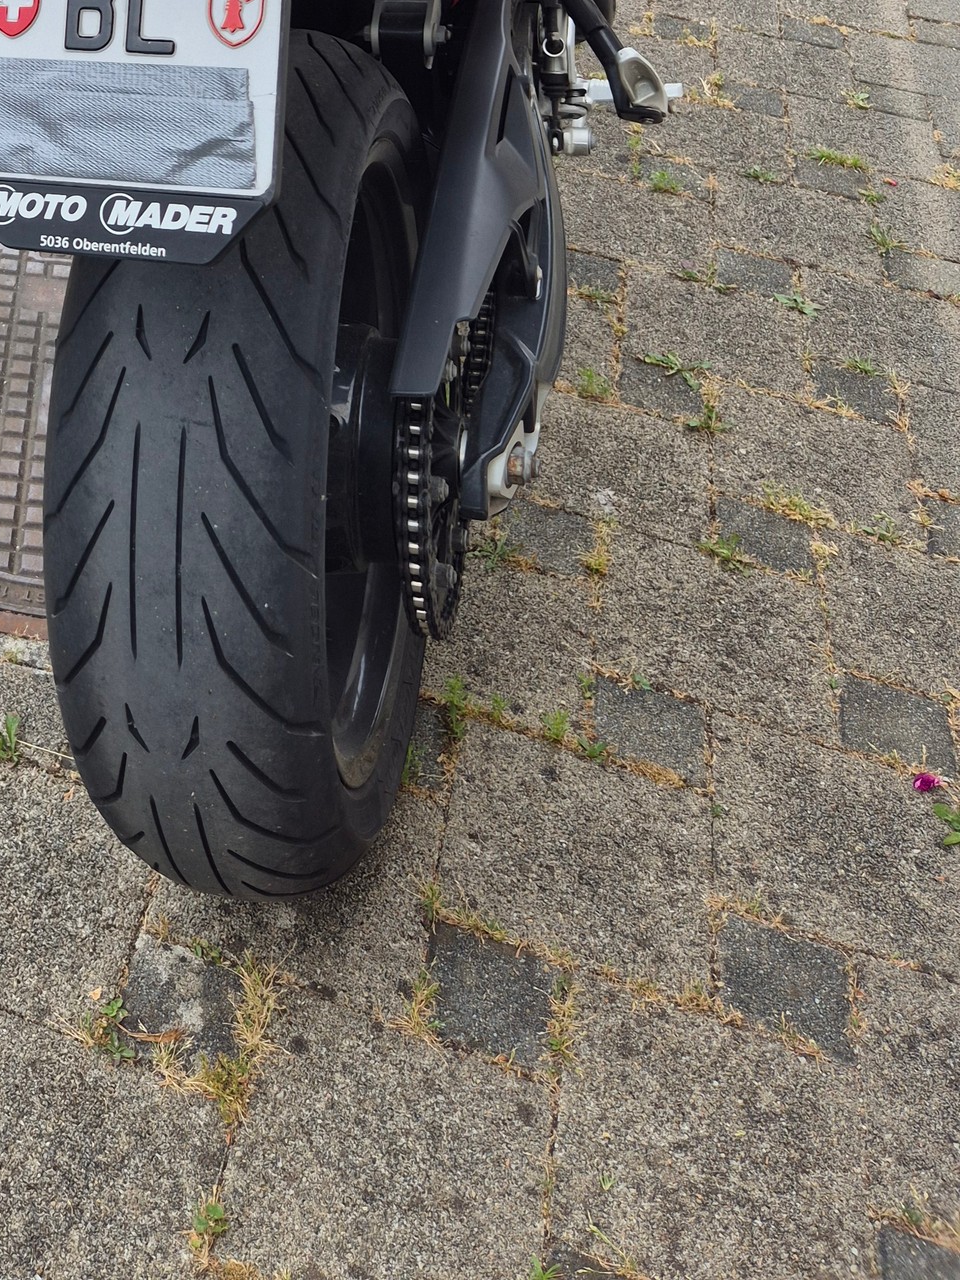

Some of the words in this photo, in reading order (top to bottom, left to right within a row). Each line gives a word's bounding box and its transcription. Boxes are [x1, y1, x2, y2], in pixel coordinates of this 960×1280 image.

[104, 197, 238, 234] MADER
[40, 235, 69, 249] 5036
[73, 238, 166, 257] Oberentfelden
